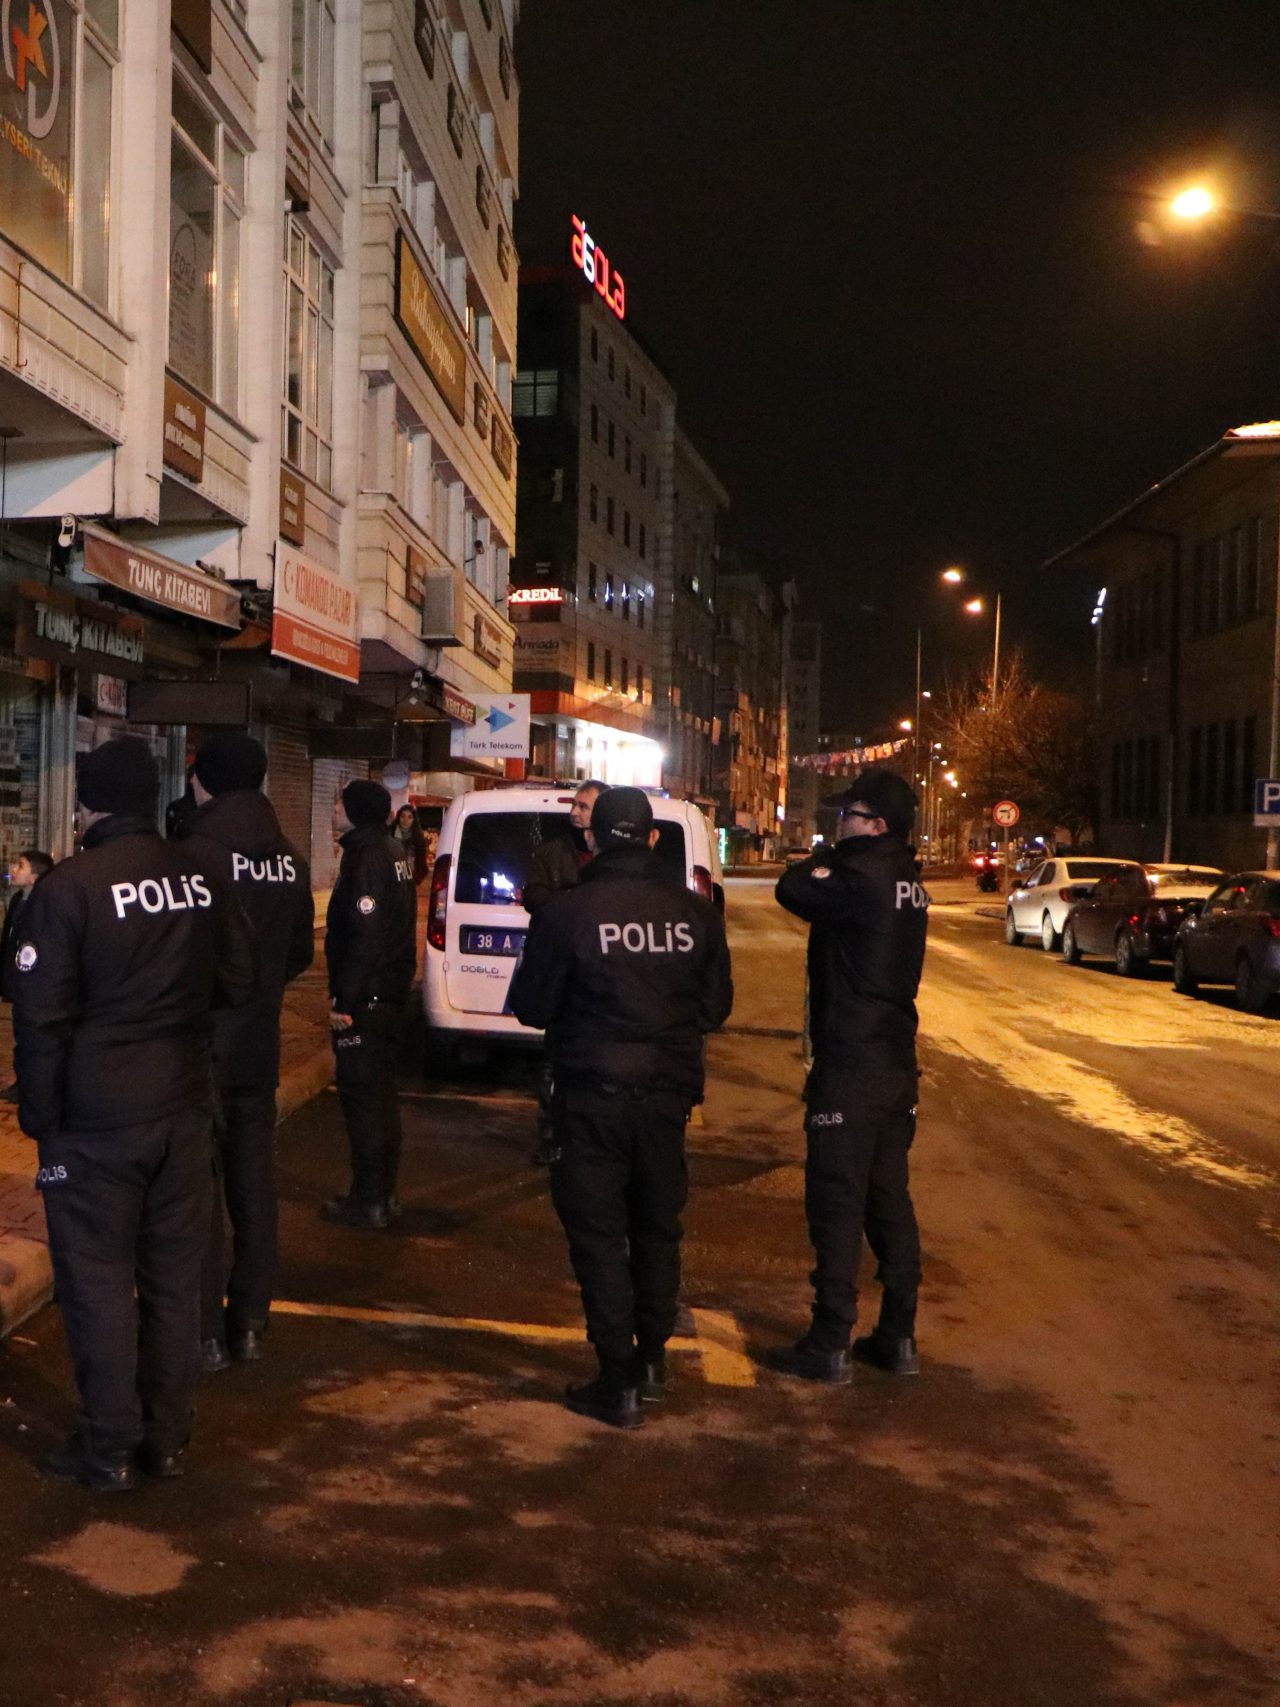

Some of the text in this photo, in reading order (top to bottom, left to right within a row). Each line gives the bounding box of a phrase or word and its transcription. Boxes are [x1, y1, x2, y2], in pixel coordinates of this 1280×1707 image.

[128, 558, 162, 599] TUNÇ
[35, 602, 79, 653] TUNÇ
[489, 740, 523, 749] Telekom
[477, 934, 493, 949] 38
[38, 1165, 67, 1181] OLiS
